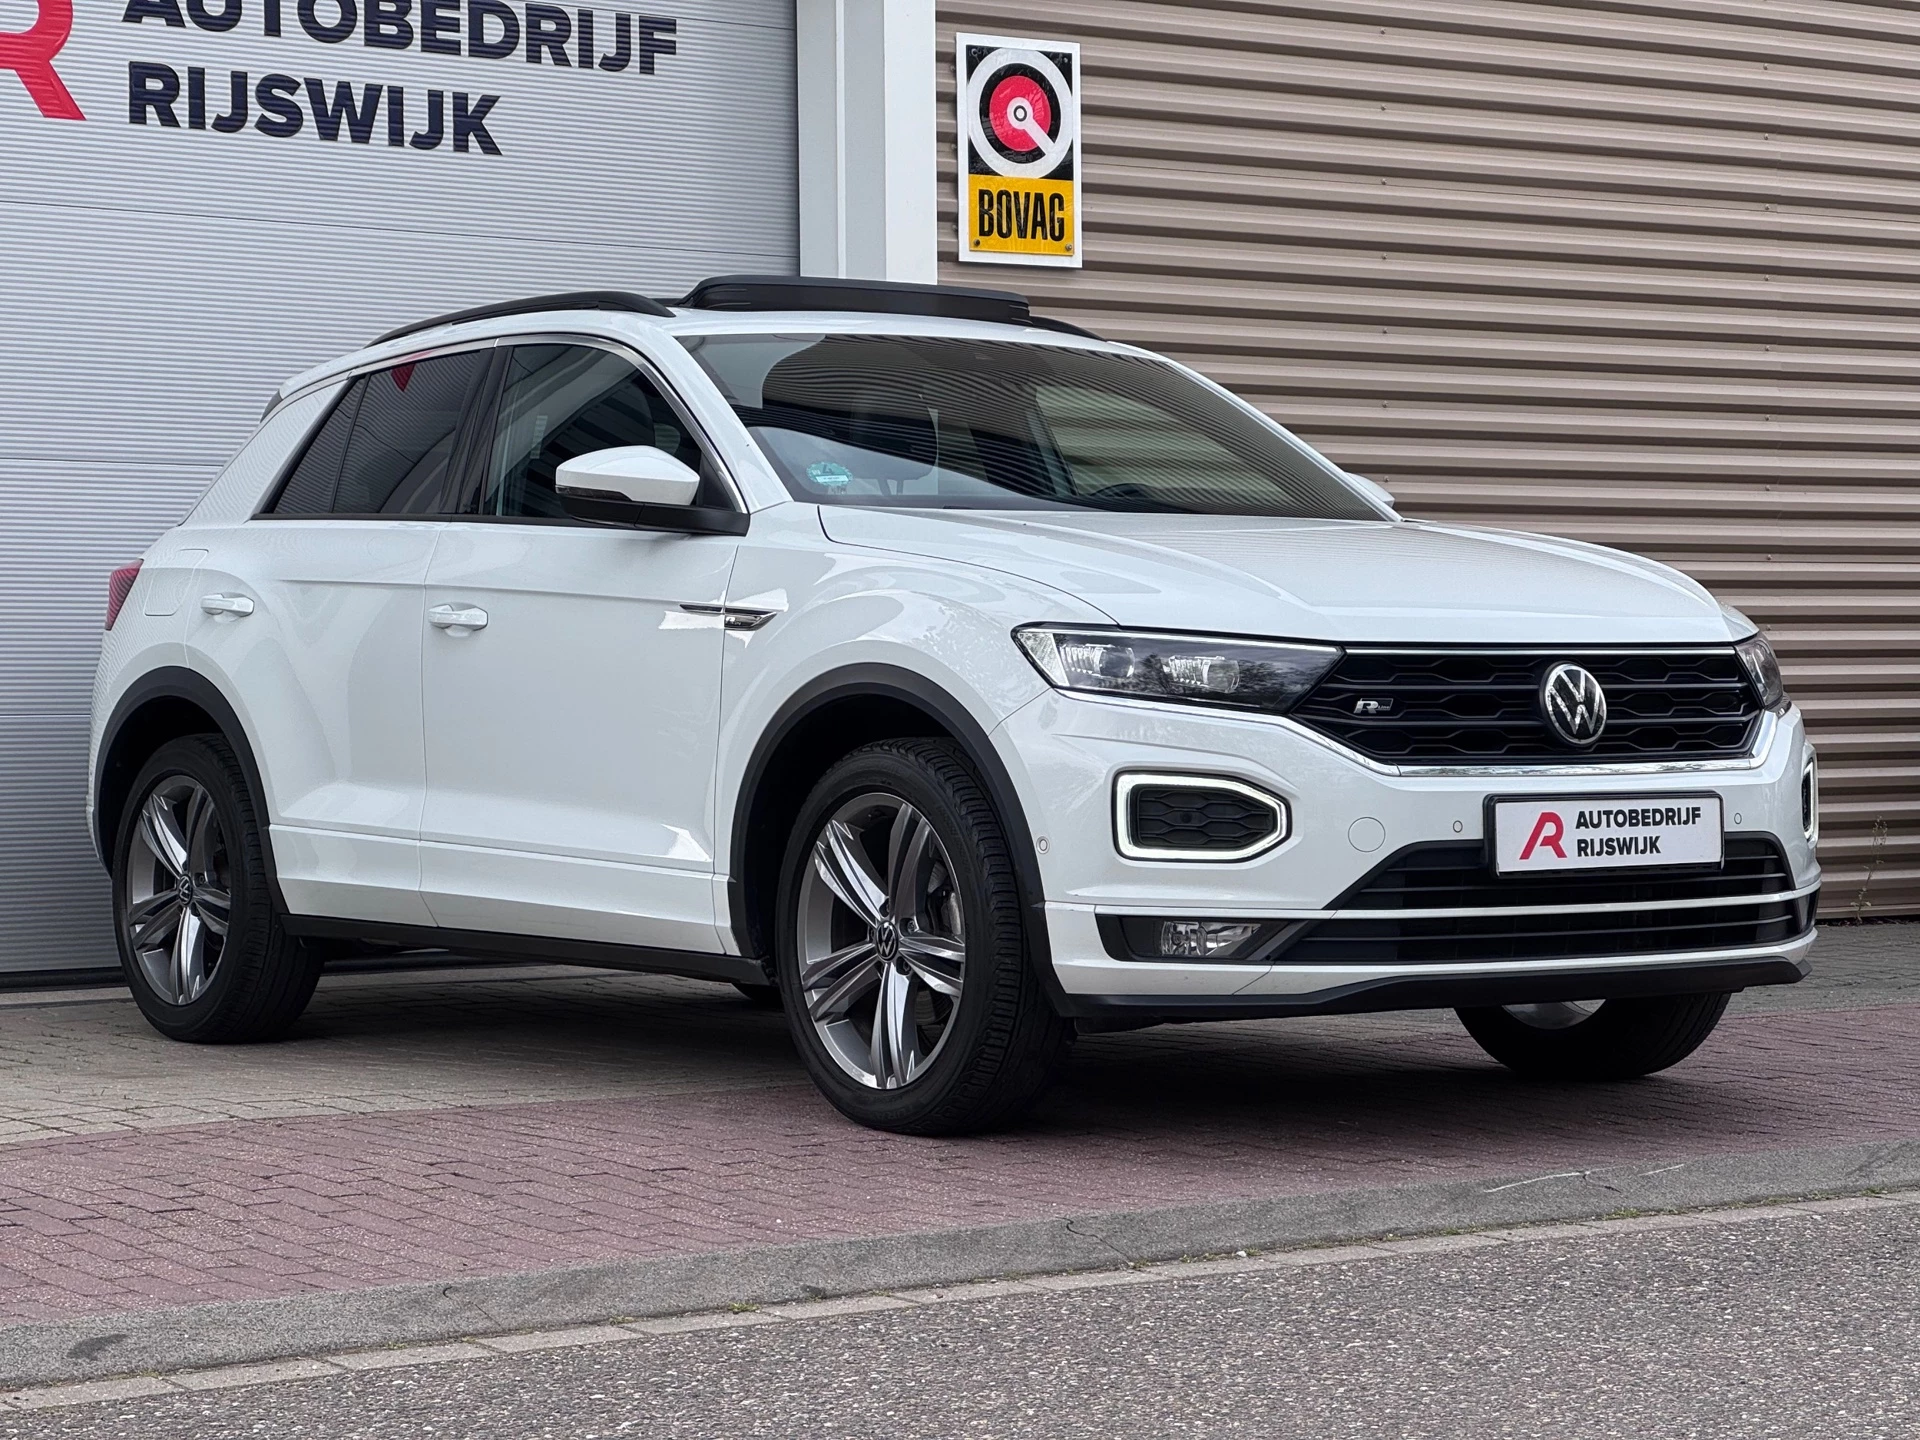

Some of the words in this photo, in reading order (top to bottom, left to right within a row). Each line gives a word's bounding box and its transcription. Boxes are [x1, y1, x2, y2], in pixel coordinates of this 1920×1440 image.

[128, 61, 503, 156] RIJSWIJK
[978, 188, 1065, 242] BOVAG
[1575, 806, 1702, 830] AUTOBEDRIJF
[1576, 836, 1662, 858] RIJSWIJK
